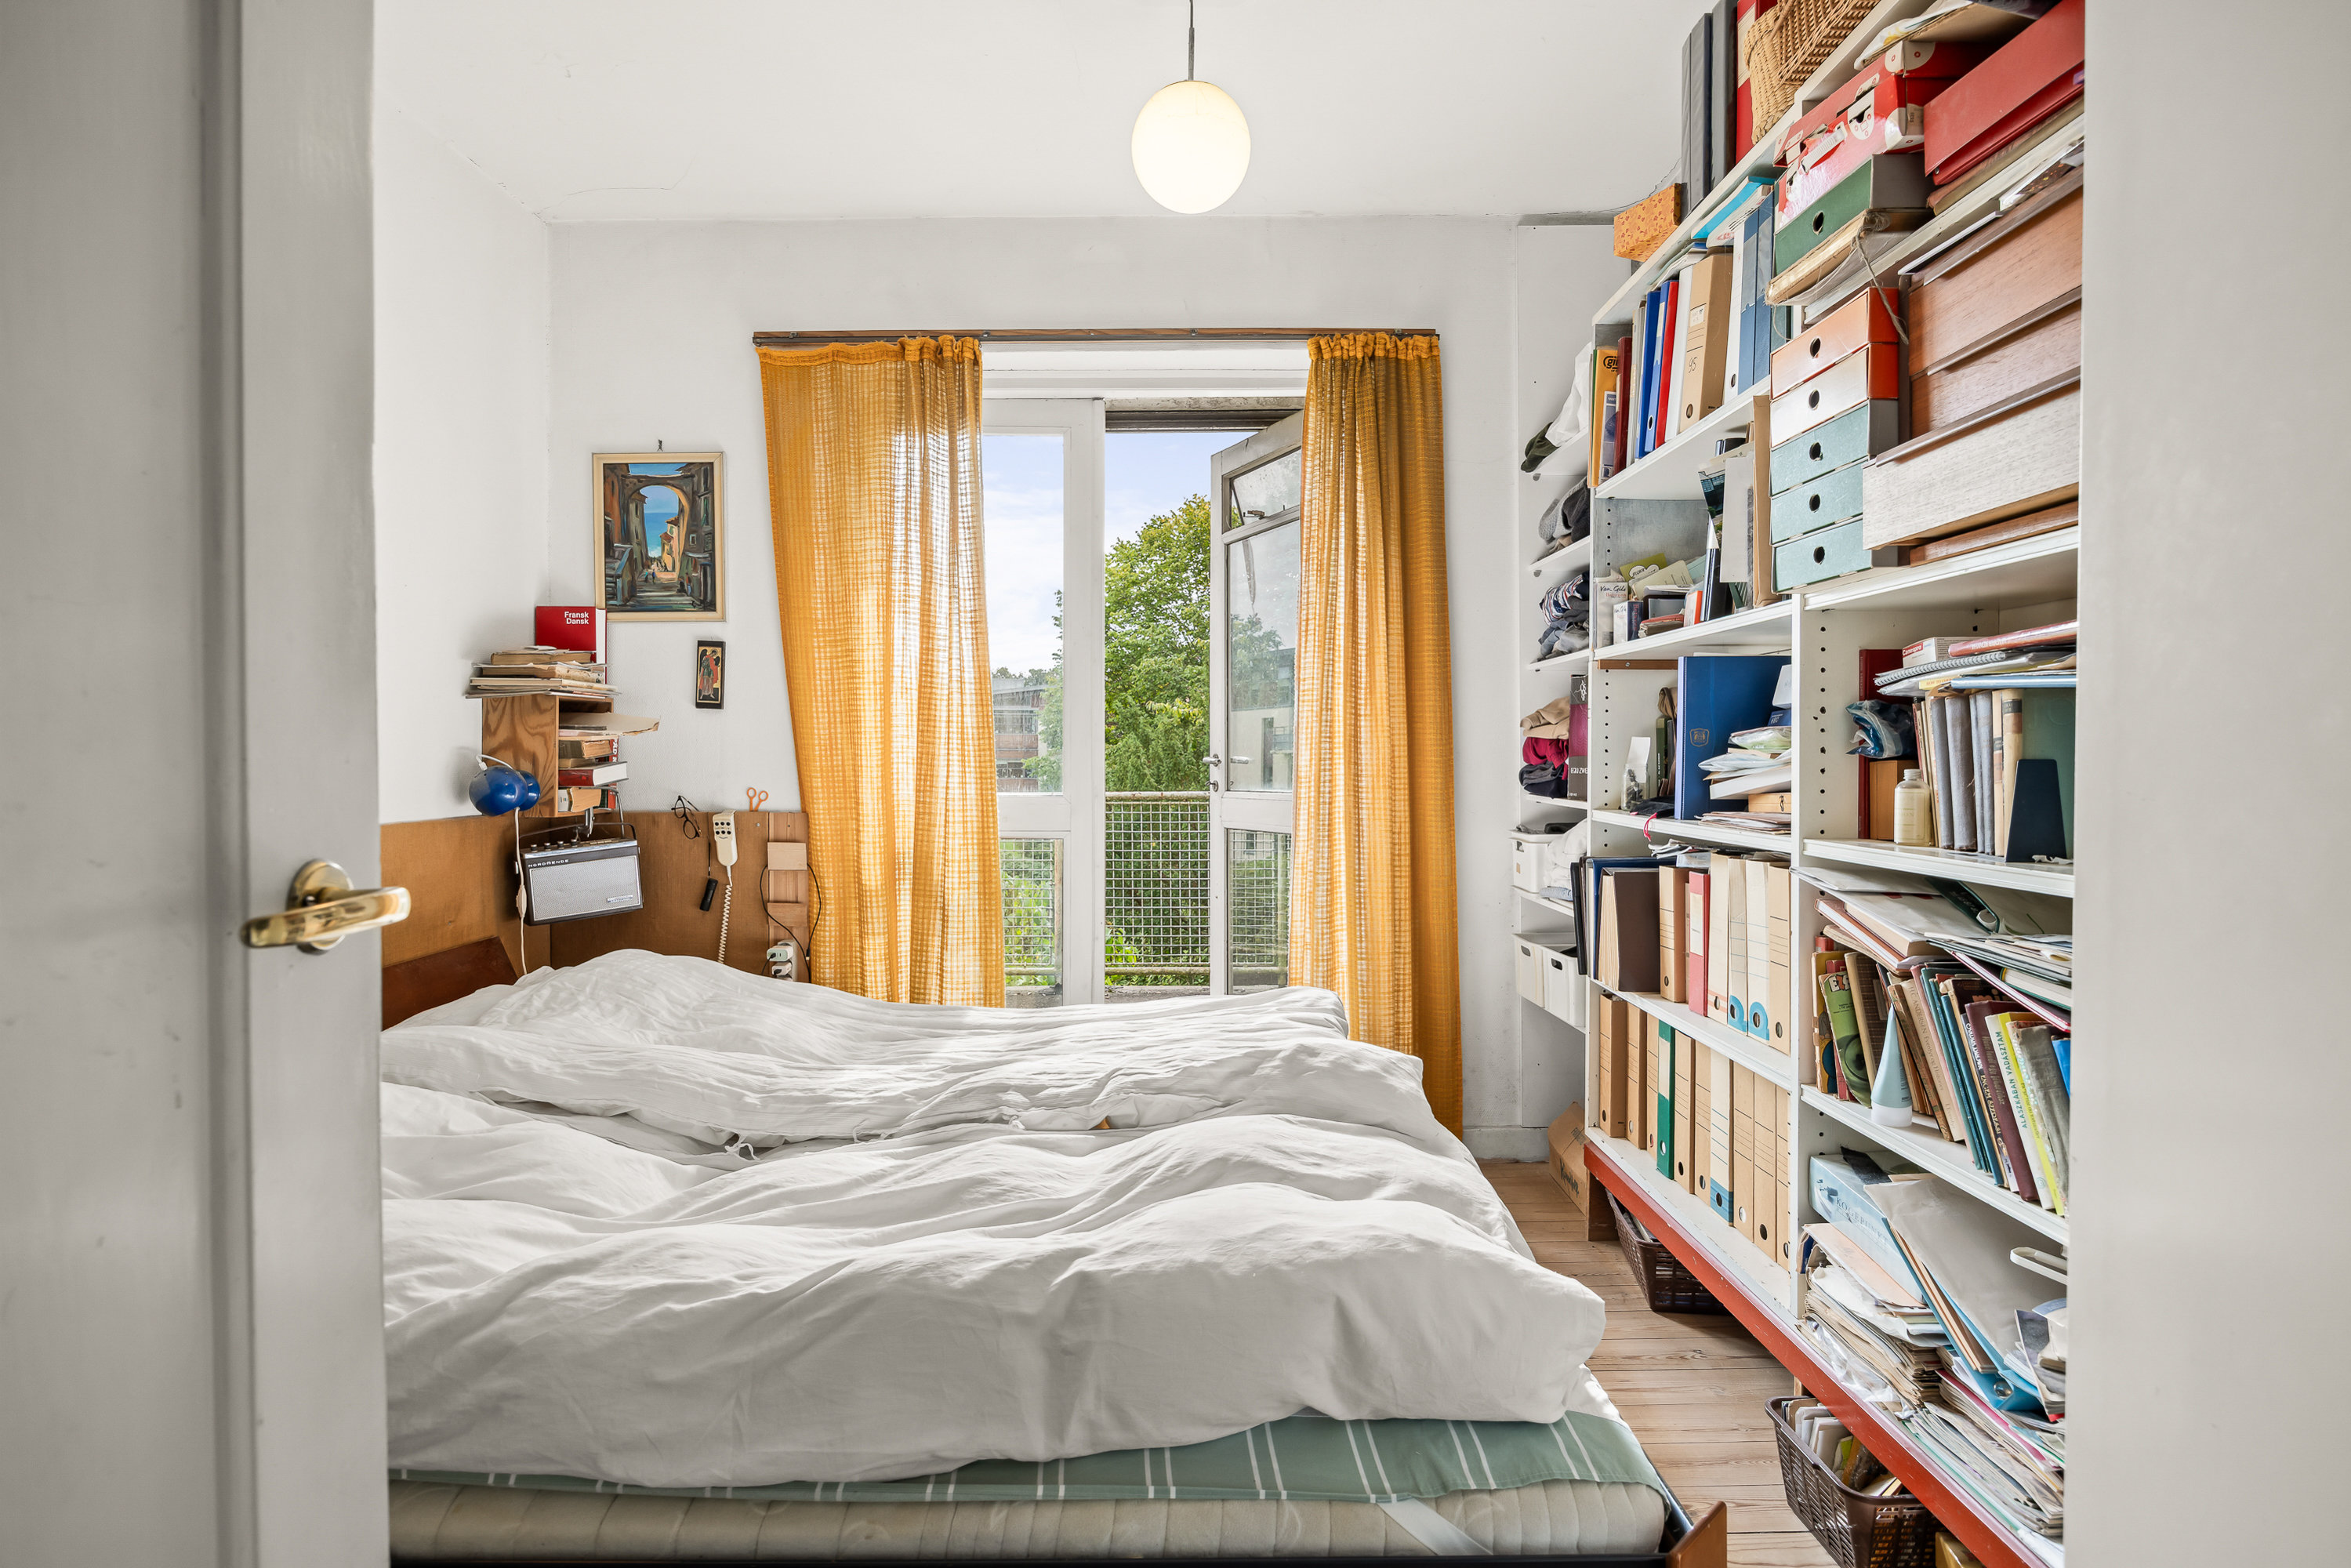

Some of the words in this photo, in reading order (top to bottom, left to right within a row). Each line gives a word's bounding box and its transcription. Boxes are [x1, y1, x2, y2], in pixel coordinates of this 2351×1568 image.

[1903, 644, 1921, 656] Canespro
[528, 858, 569, 868] NORDMENDE
[1913, 998, 1927, 1033] ANDERSEN
[1924, 1036, 1933, 1058] Eventyr
[1994, 1031, 2012, 1075] VADÁSZTAM
[2008, 1078, 2028, 1128] ALASZKÁBAN
